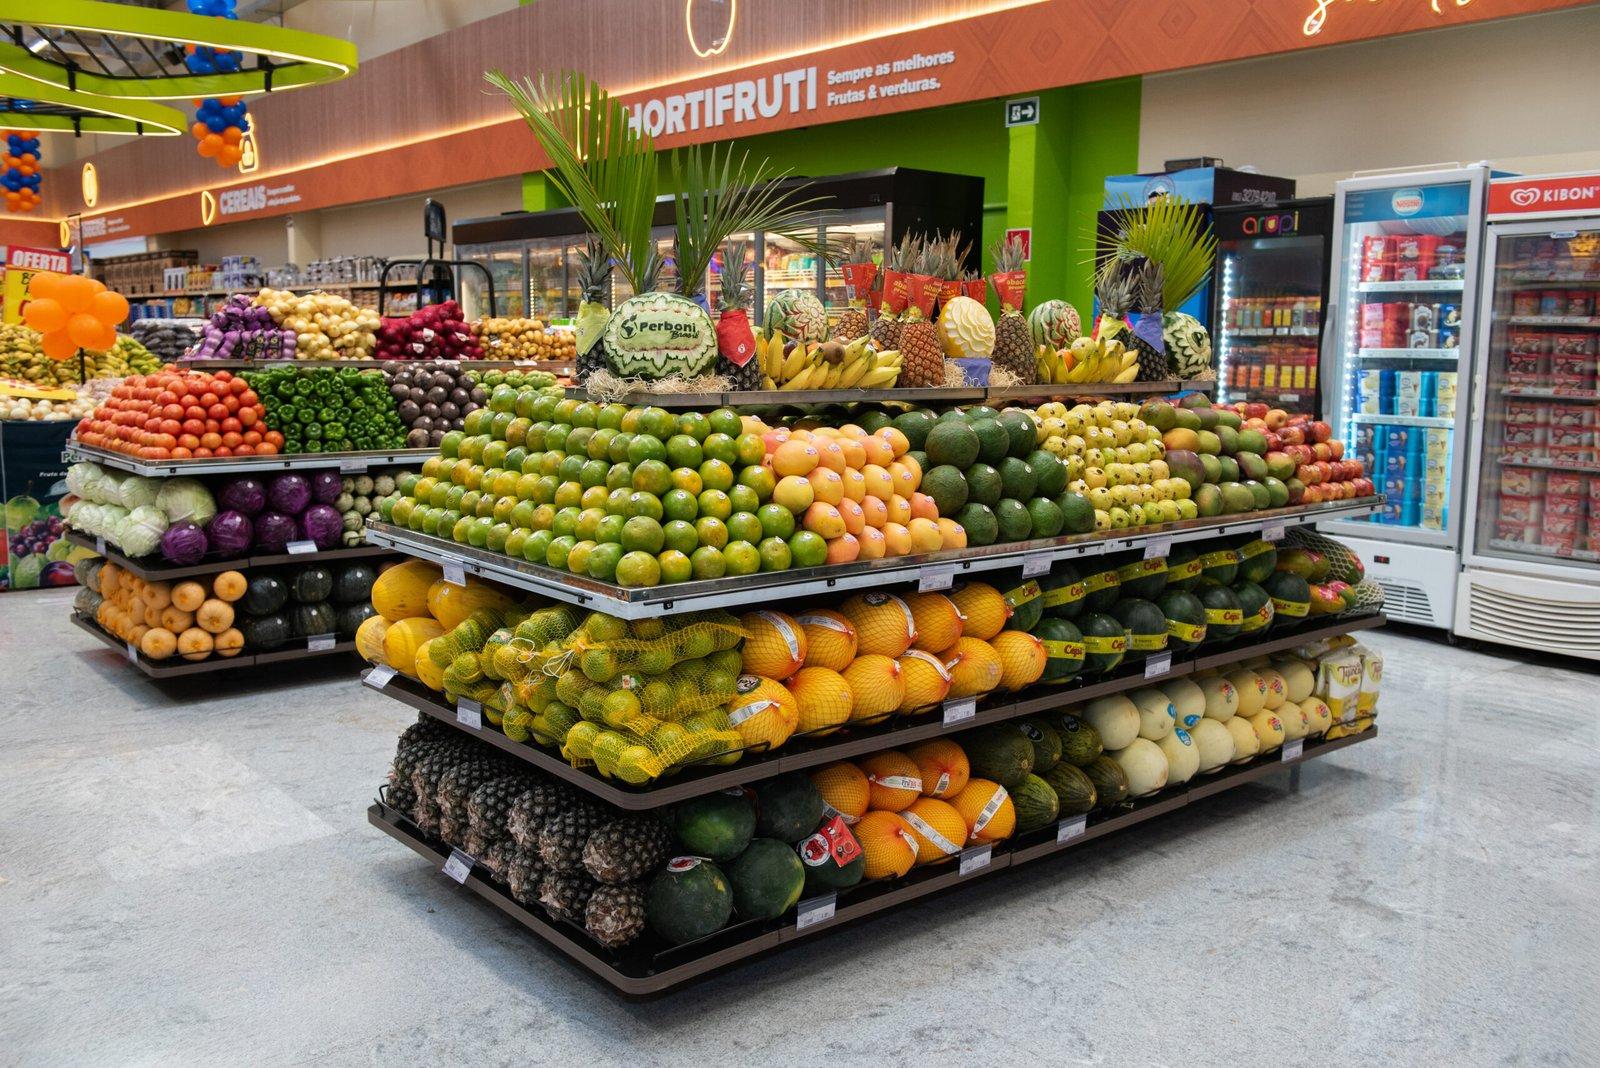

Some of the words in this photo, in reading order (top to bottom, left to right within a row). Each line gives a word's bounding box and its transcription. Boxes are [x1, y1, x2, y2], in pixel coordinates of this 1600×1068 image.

[827, 66, 873, 85] Sempre
[875, 62, 890, 76] as
[893, 51, 955, 72] melhores
[622, 67, 817, 141] HORTIFRUTI
[827, 89, 866, 106] Frutas
[868, 84, 877, 100] &
[880, 78, 941, 97] verduras.
[220, 185, 267, 215] CEREAIS
[1543, 186, 1594, 202] KIBON
[12, 250, 68, 273] OFERTA
[640, 321, 696, 332] Perboni
